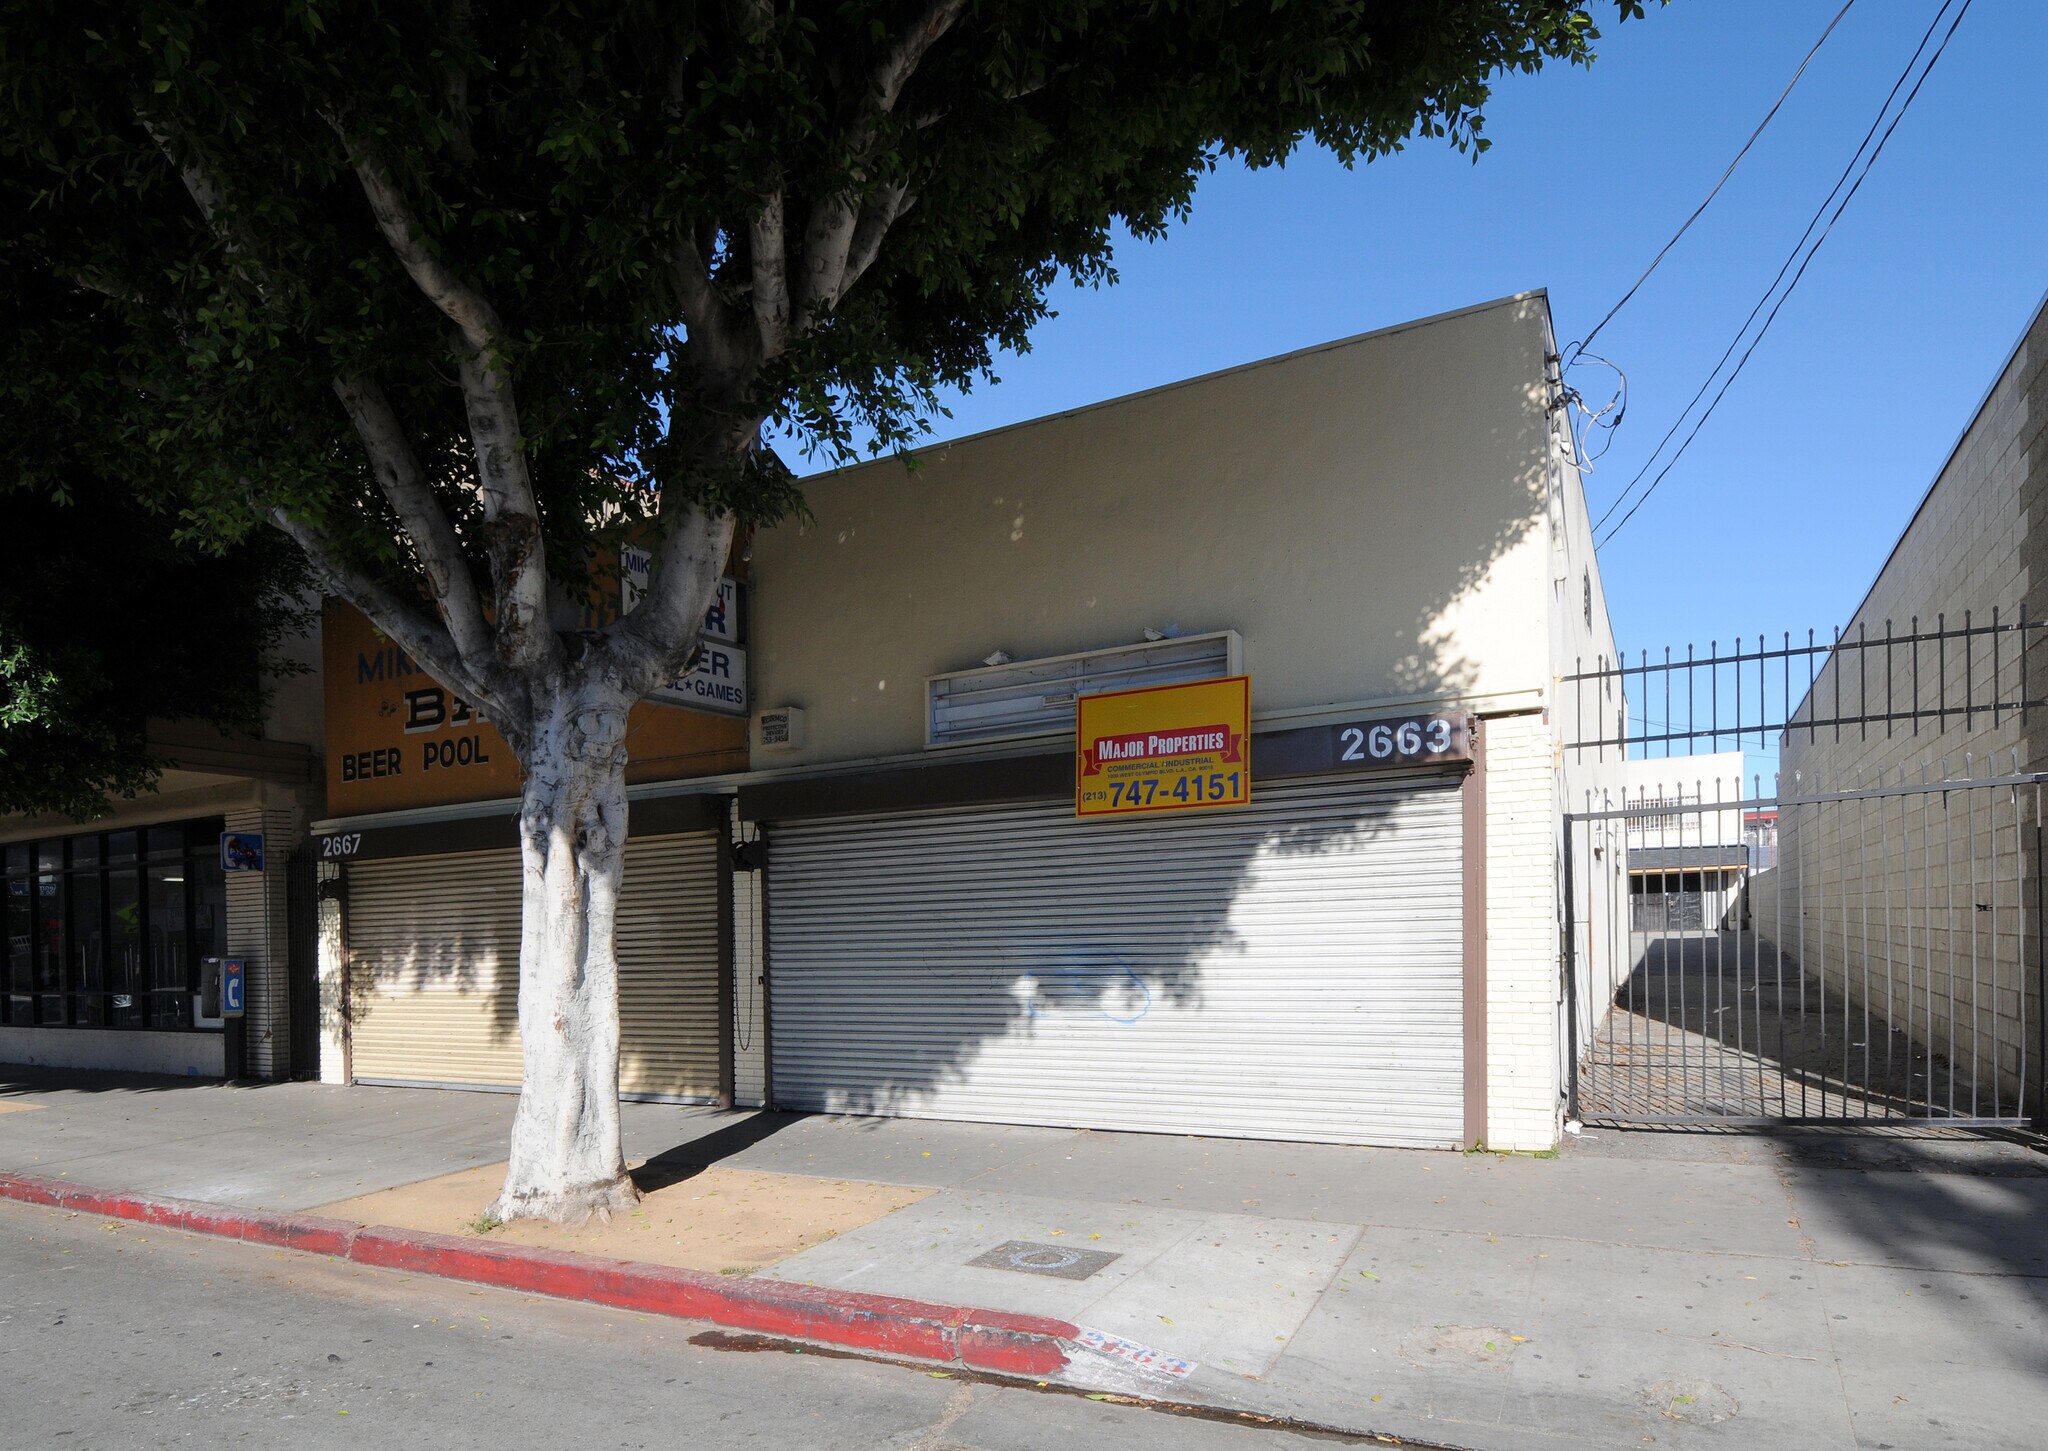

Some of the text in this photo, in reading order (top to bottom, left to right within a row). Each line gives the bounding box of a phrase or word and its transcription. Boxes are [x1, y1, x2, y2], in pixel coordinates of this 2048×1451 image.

[625, 552, 650, 575] MIK
[357, 646, 426, 685] MIK
[698, 648, 730, 679] ER
[695, 679, 743, 704] GAMES
[1341, 718, 1452, 762] 2663
[342, 735, 489, 783] BEER POOL
[1107, 761, 1159, 773] COMMERCIAL
[1082, 771, 1239, 808] (213) 747-4151
[322, 833, 362, 858] 2667
